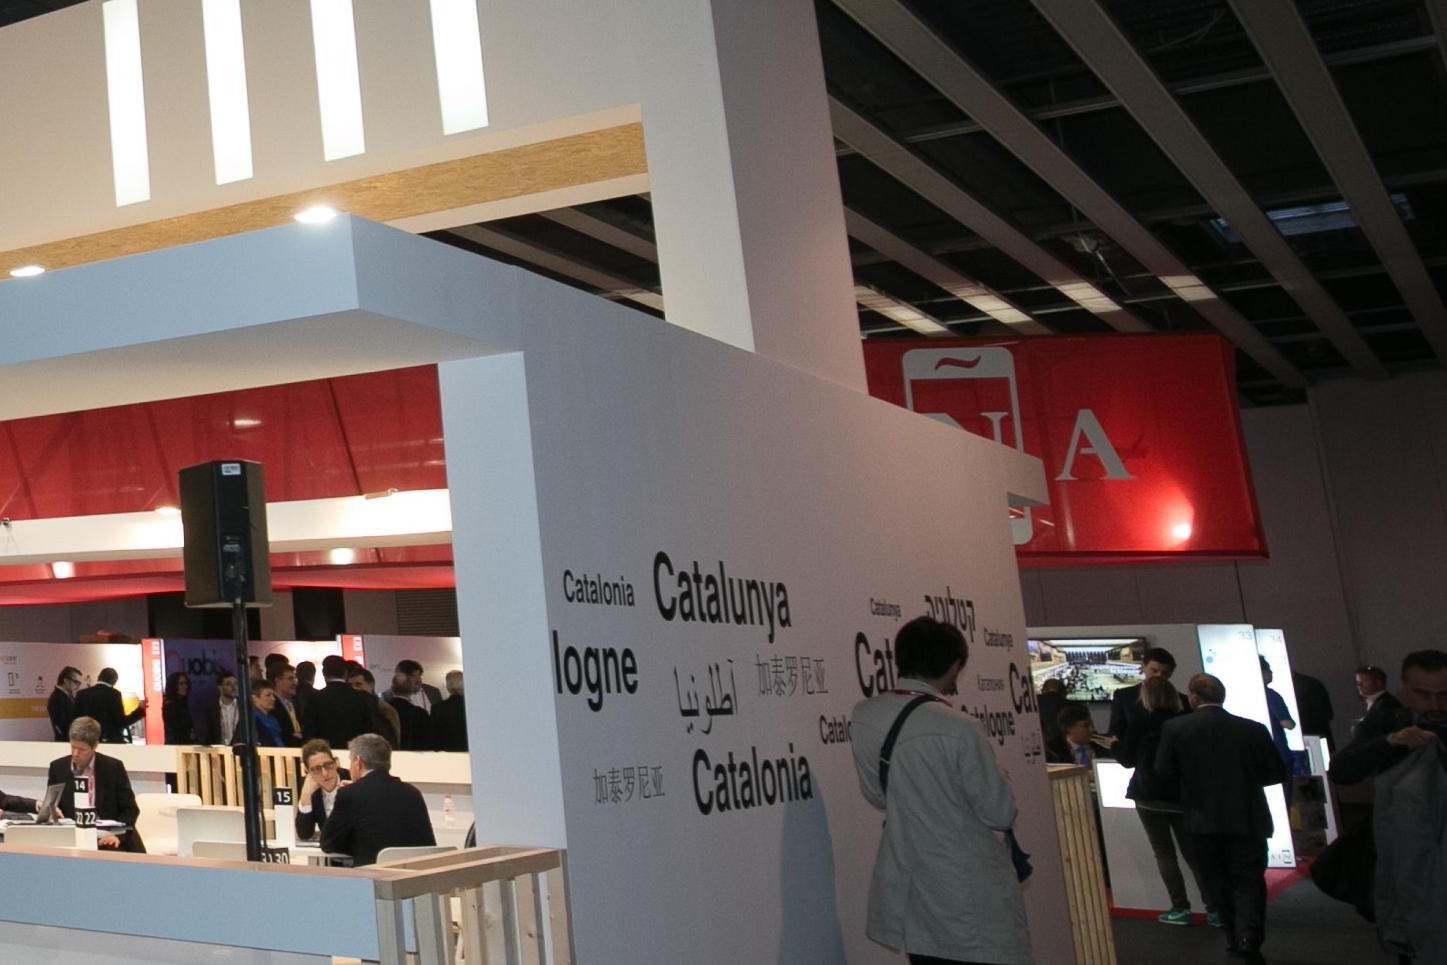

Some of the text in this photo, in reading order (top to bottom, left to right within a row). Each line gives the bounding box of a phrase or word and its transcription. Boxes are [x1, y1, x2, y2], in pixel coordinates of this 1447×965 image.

[563, 569, 635, 607] Catalonia
[653, 551, 792, 644] Catalunya
[74, 780, 86, 791] 14
[693, 742, 813, 815] Catalonia
[276, 791, 291, 803] 15
[84, 811, 97, 825] 22
